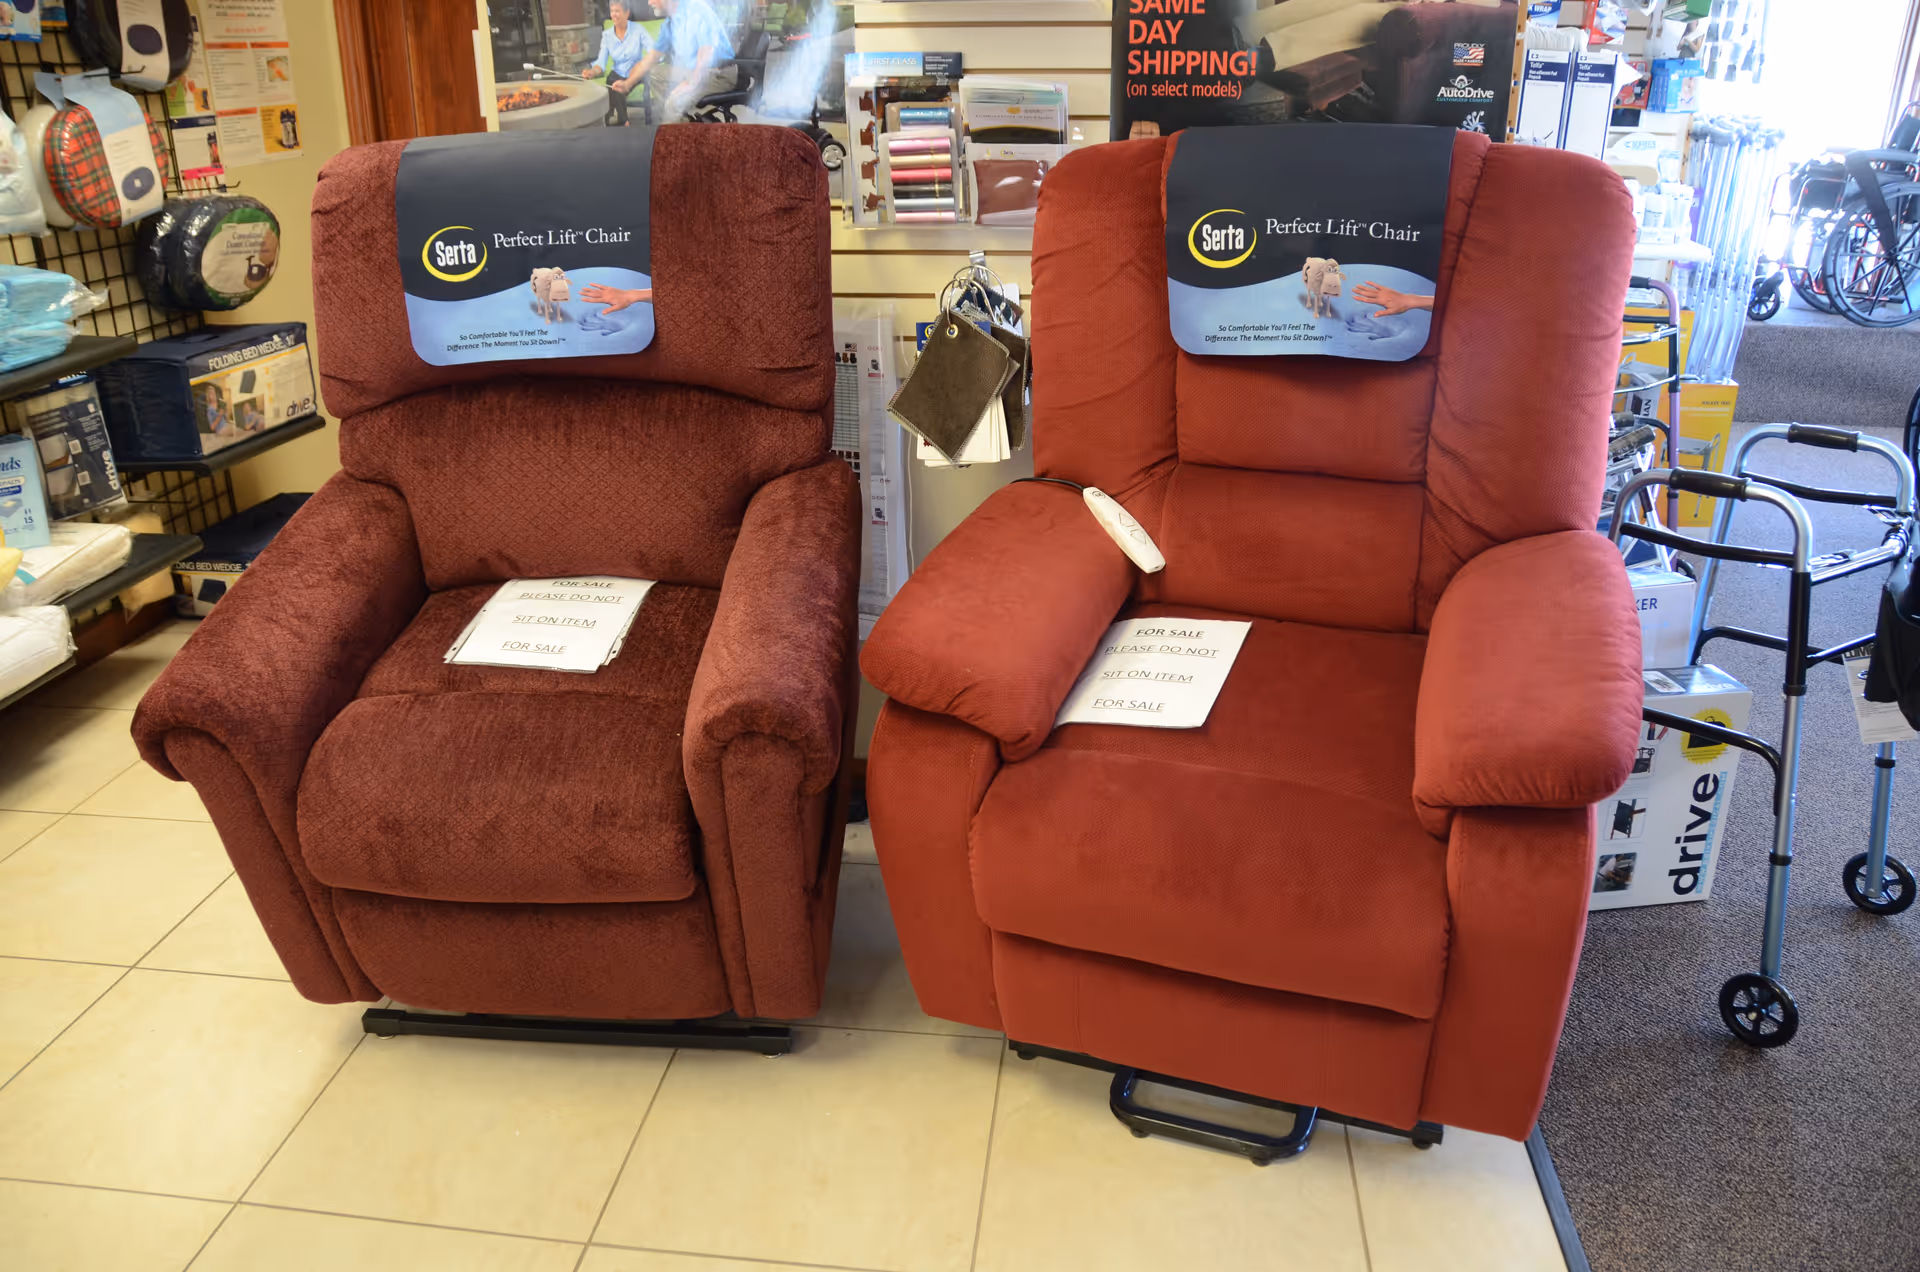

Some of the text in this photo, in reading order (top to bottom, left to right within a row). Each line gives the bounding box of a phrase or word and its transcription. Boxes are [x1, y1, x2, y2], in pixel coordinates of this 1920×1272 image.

[1128, 19, 1184, 45] DAY
[892, 57, 917, 65] CLASS
[1127, 49, 1257, 77] SHIPPING!
[1127, 80, 1242, 100] (on select models)
[1437, 86, 1495, 99] AutoDrive
[1266, 218, 1321, 235] Perfect
[1369, 221, 1421, 242] Chair
[493, 232, 543, 248] Perfect
[585, 227, 631, 244] Chair
[1202, 223, 1245, 251] Serta
[435, 240, 477, 267] Serta
[1218, 323, 1316, 332] So Comfortable You'll Feel The
[469, 331, 507, 340] Comfortable
[1205, 334, 1238, 343] Difference
[447, 343, 479, 352] Difference
[208, 350, 242, 371] FOLDING
[242, 345, 258, 360] BED
[286, 397, 310, 417] drive
[102, 450, 120, 490] drive
[196, 562, 212, 570] BED
[552, 580, 614, 588] FOR SALE
[518, 592, 624, 603] PLEASE DO NOT
[513, 615, 597, 628] SIT ON ITEM
[1135, 628, 1205, 638] FOR SALE
[501, 640, 567, 653] FOR SALE
[1104, 644, 1220, 657] PLEASE DO NOT
[1102, 670, 1194, 682] SIT ON ITEM
[1093, 698, 1166, 711] FOR SALE
[1668, 773, 1720, 896] drive
